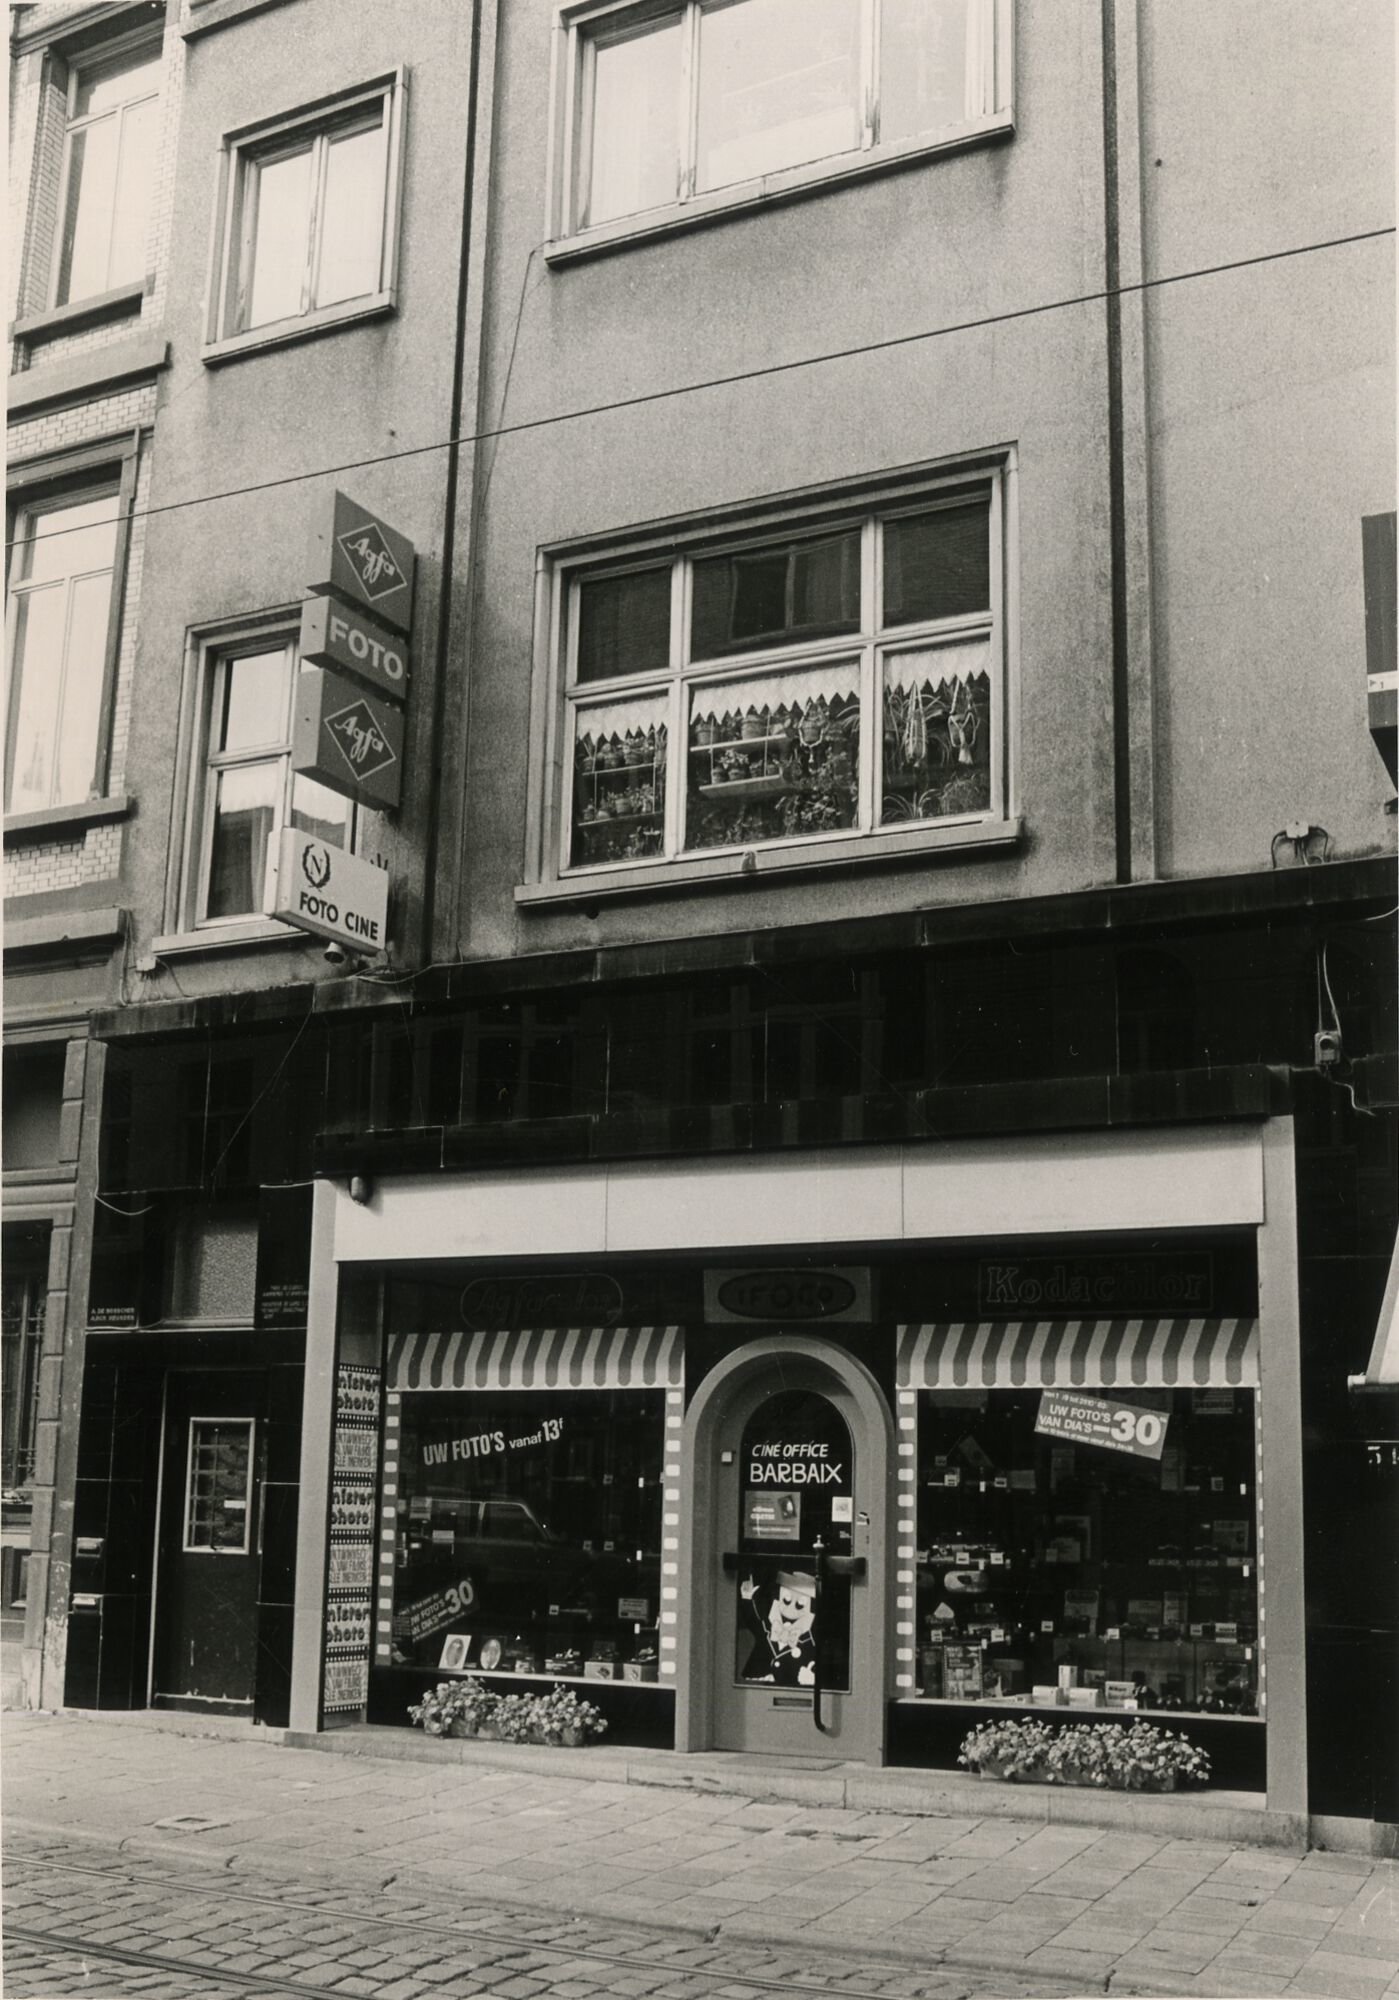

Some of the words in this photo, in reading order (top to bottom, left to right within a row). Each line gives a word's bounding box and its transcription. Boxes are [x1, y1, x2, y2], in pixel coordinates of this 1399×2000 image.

[346, 537, 396, 584] Agfa
[329, 616, 404, 680] FOTO
[334, 715, 385, 763] Agfa
[299, 891, 339, 923] FOTO
[345, 911, 379, 941] CINE
[985, 1264, 1205, 1303] Kodacolor
[1039, 1414, 1061, 1428] VAN
[1063, 1418, 1092, 1434] DIA'S
[1049, 1404, 1069, 1416] UW
[1070, 1407, 1112, 1423] FOTO'S
[423, 1442, 448, 1466] UW
[451, 1431, 506, 1461] FOTO'S
[509, 1430, 542, 1449] vanaf
[750, 1463, 842, 1484] BARBAIX
[444, 1580, 474, 1614] 30
